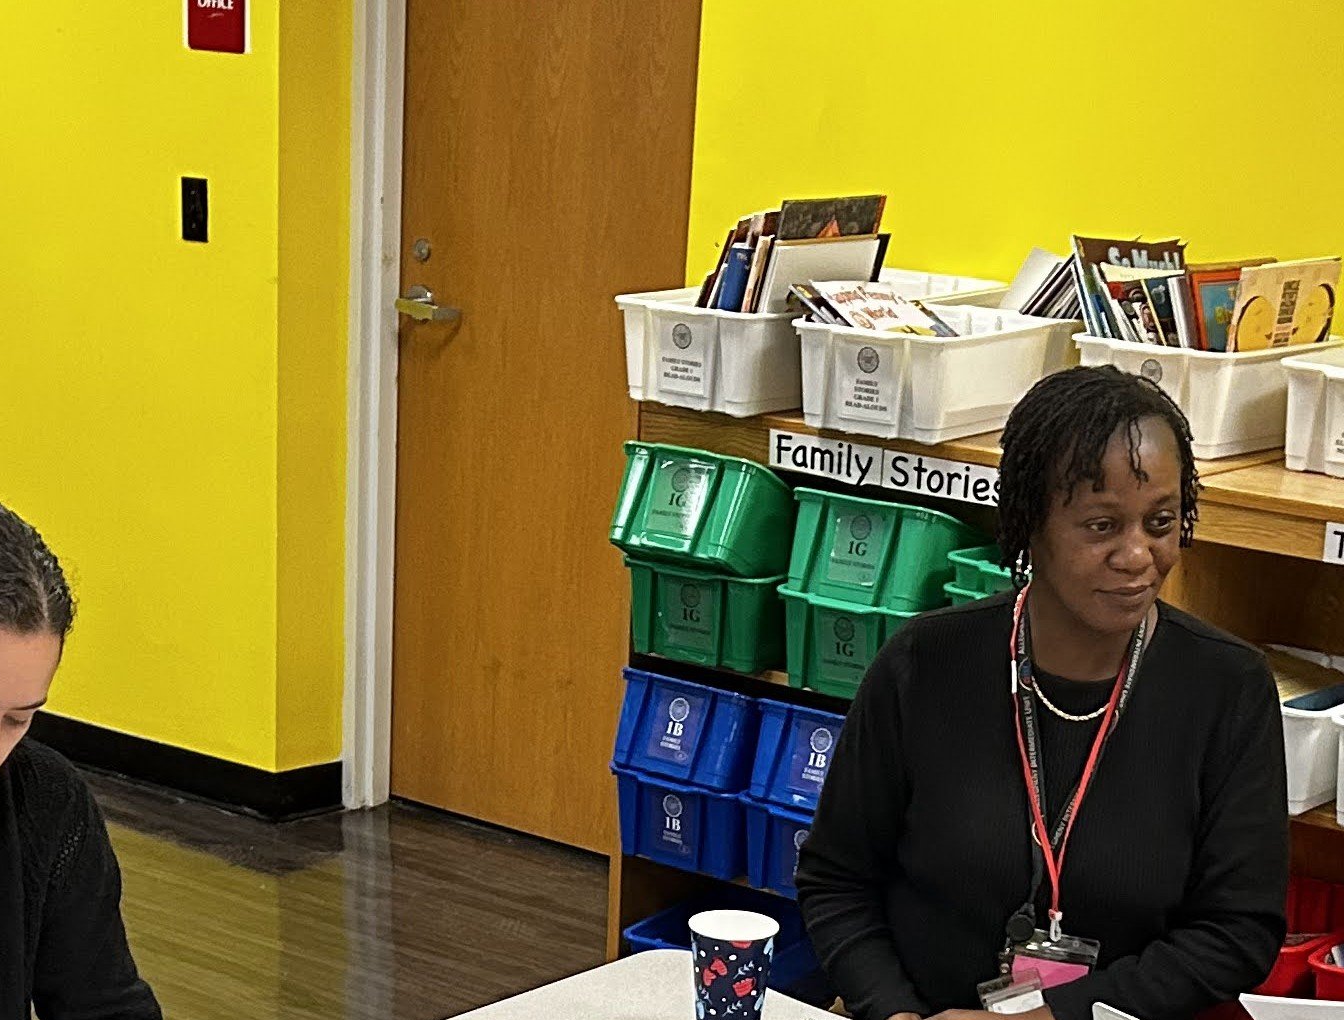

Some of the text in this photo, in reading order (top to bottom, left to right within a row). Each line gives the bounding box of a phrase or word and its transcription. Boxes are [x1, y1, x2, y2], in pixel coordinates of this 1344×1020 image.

[776, 434, 1001, 503] Family Stories
[666, 720, 684, 736] 1B
[808, 752, 827, 768] 1B
[665, 816, 681, 831] 1B
